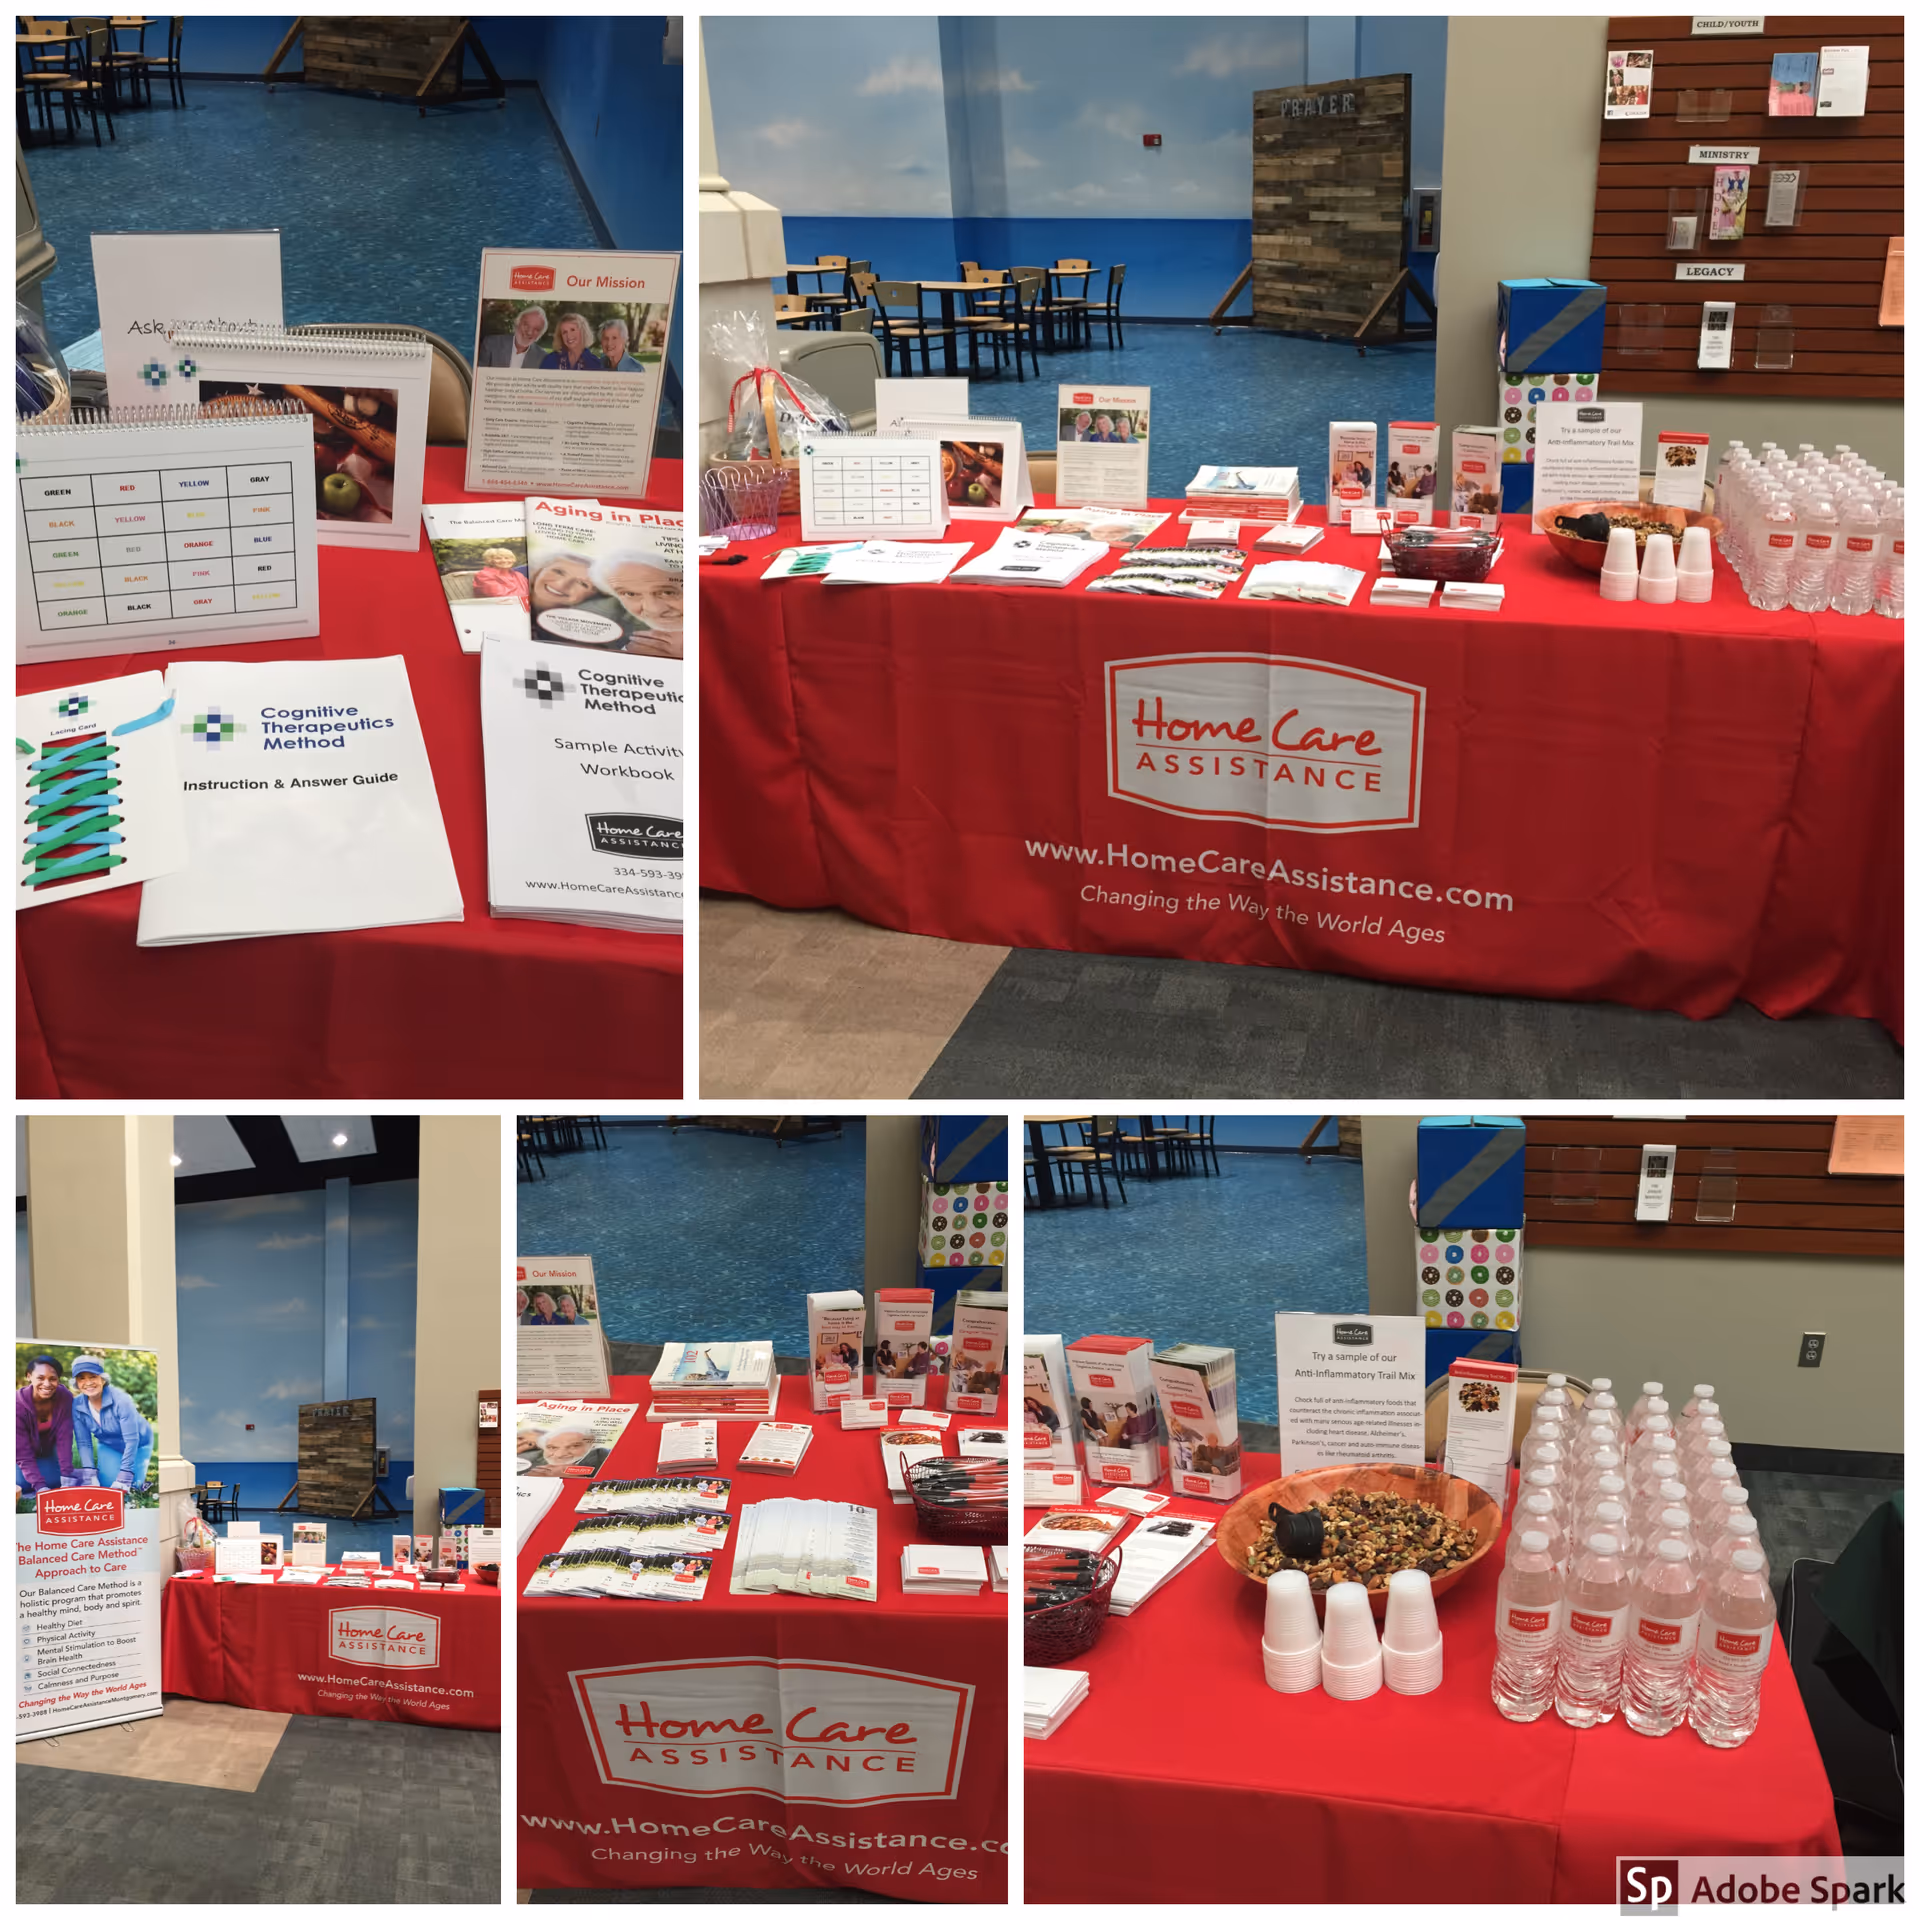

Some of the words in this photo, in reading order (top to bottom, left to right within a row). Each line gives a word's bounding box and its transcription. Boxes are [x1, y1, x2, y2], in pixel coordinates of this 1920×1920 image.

[1697, 20, 1759, 28] CHILD/YOUTH
[1281, 93, 1355, 118] PRAYER
[1699, 151, 1749, 159] MINISTRY
[514, 272, 533, 280] Home
[1686, 267, 1734, 276] LEGACY
[567, 275, 592, 287] Our
[596, 276, 645, 288] Mission
[128, 320, 164, 334] Ask
[44, 489, 71, 497] GREEN
[115, 515, 146, 523] YELLOW
[535, 501, 602, 521] Aging
[611, 512, 630, 522] in
[184, 540, 213, 548] ORANGE
[578, 669, 664, 687] Cognitive
[261, 706, 358, 721] Cognitive
[584, 699, 656, 715] Method
[50, 727, 76, 736] Lacing
[262, 717, 394, 737] Therapeutics
[1133, 696, 1261, 743] Home
[1272, 709, 1382, 756] Care
[263, 736, 345, 750] Method
[554, 738, 618, 754] Sample
[580, 763, 675, 781] Workbook
[1136, 754, 1381, 792] ASSISTANCE
[183, 779, 268, 791] Instruction
[274, 779, 284, 789] &
[290, 776, 348, 788] Answer
[353, 772, 398, 785] Guide
[597, 822, 642, 836] Home
[646, 826, 683, 838] Care
[1025, 839, 1514, 912] www.HomeCareAssistance.com
[1080, 885, 1179, 914] Changing
[1186, 890, 1221, 910] the
[1228, 893, 1269, 921] Way
[1276, 902, 1309, 926] the
[1316, 913, 1381, 936] World
[1388, 917, 1446, 944] Ages
[532, 1270, 546, 1278] Our
[549, 1270, 576, 1278] Mission
[1312, 1352, 1326, 1361] Try
[1336, 1353, 1368, 1362] sample
[1370, 1353, 1379, 1361] of
[1295, 1369, 1376, 1380] Anti-Inflammatory
[1378, 1369, 1396, 1379] Trail
[1399, 1371, 1415, 1380] Mix
[538, 1402, 577, 1412] Aging
[44, 1498, 81, 1513] Home
[84, 1500, 114, 1510] Care
[45, 1514, 115, 1524] ASSISTANCE
[35, 1541, 67, 1551] Home
[71, 1540, 94, 1548] Care
[97, 1535, 148, 1546] Assistance
[18, 1554, 68, 1566] Balanced
[71, 1551, 95, 1561] Care
[35, 1567, 87, 1580] Approach
[90, 1565, 100, 1574] to
[104, 1563, 127, 1572] Care
[19, 1589, 36, 1598] Our
[39, 1585, 75, 1596] Balanced
[77, 1583, 96, 1592] Care
[98, 1581, 128, 1591] Method
[20, 1598, 49, 1608] holistic
[51, 1595, 86, 1608] program
[88, 1593, 103, 1601] that
[106, 1590, 141, 1602] promotes
[27, 1608, 57, 1619] healthy
[60, 1605, 81, 1615] mind,
[84, 1602, 103, 1613] body
[106, 1601, 120, 1609] and
[1512, 1613, 1530, 1622] Home
[36, 1621, 66, 1632] Healthy
[68, 1619, 82, 1627] Diet
[338, 1621, 383, 1638] Home
[387, 1625, 425, 1642] Care
[37, 1634, 67, 1644] Physical
[69, 1630, 96, 1640] Activity
[37, 1646, 63, 1656] Mental
[66, 1641, 105, 1652] Stimulation
[116, 1636, 136, 1645] Boost
[339, 1642, 426, 1655] ASSISTANCE
[37, 1656, 57, 1665] Brain
[59, 1652, 82, 1662] Health
[37, 1668, 60, 1678] Social
[62, 1660, 116, 1674] Connectedness
[38, 1680, 73, 1690] Calmness
[91, 1671, 119, 1683] Purpose
[298, 1672, 474, 1698] www.HomeCareAssistance.com
[18, 1696, 56, 1709] Changing
[59, 1694, 71, 1702] the
[73, 1692, 90, 1701] Way
[105, 1685, 127, 1694] World
[129, 1682, 147, 1692] Ages
[317, 1689, 354, 1702] Changing
[355, 1692, 368, 1700] the
[370, 1693, 386, 1704] Way
[388, 1696, 400, 1705] the
[403, 1699, 426, 1709] World
[429, 1701, 450, 1711] Ages
[615, 1701, 773, 1739] Home
[786, 1707, 917, 1743] Care
[629, 1745, 916, 1773] ASSISTANCE
[592, 1848, 697, 1863] Changing
[704, 1844, 741, 1861] the
[748, 1844, 793, 1865] Way
[800, 1854, 835, 1872] the
[844, 1861, 911, 1877] World
[919, 1862, 978, 1880] Ages
